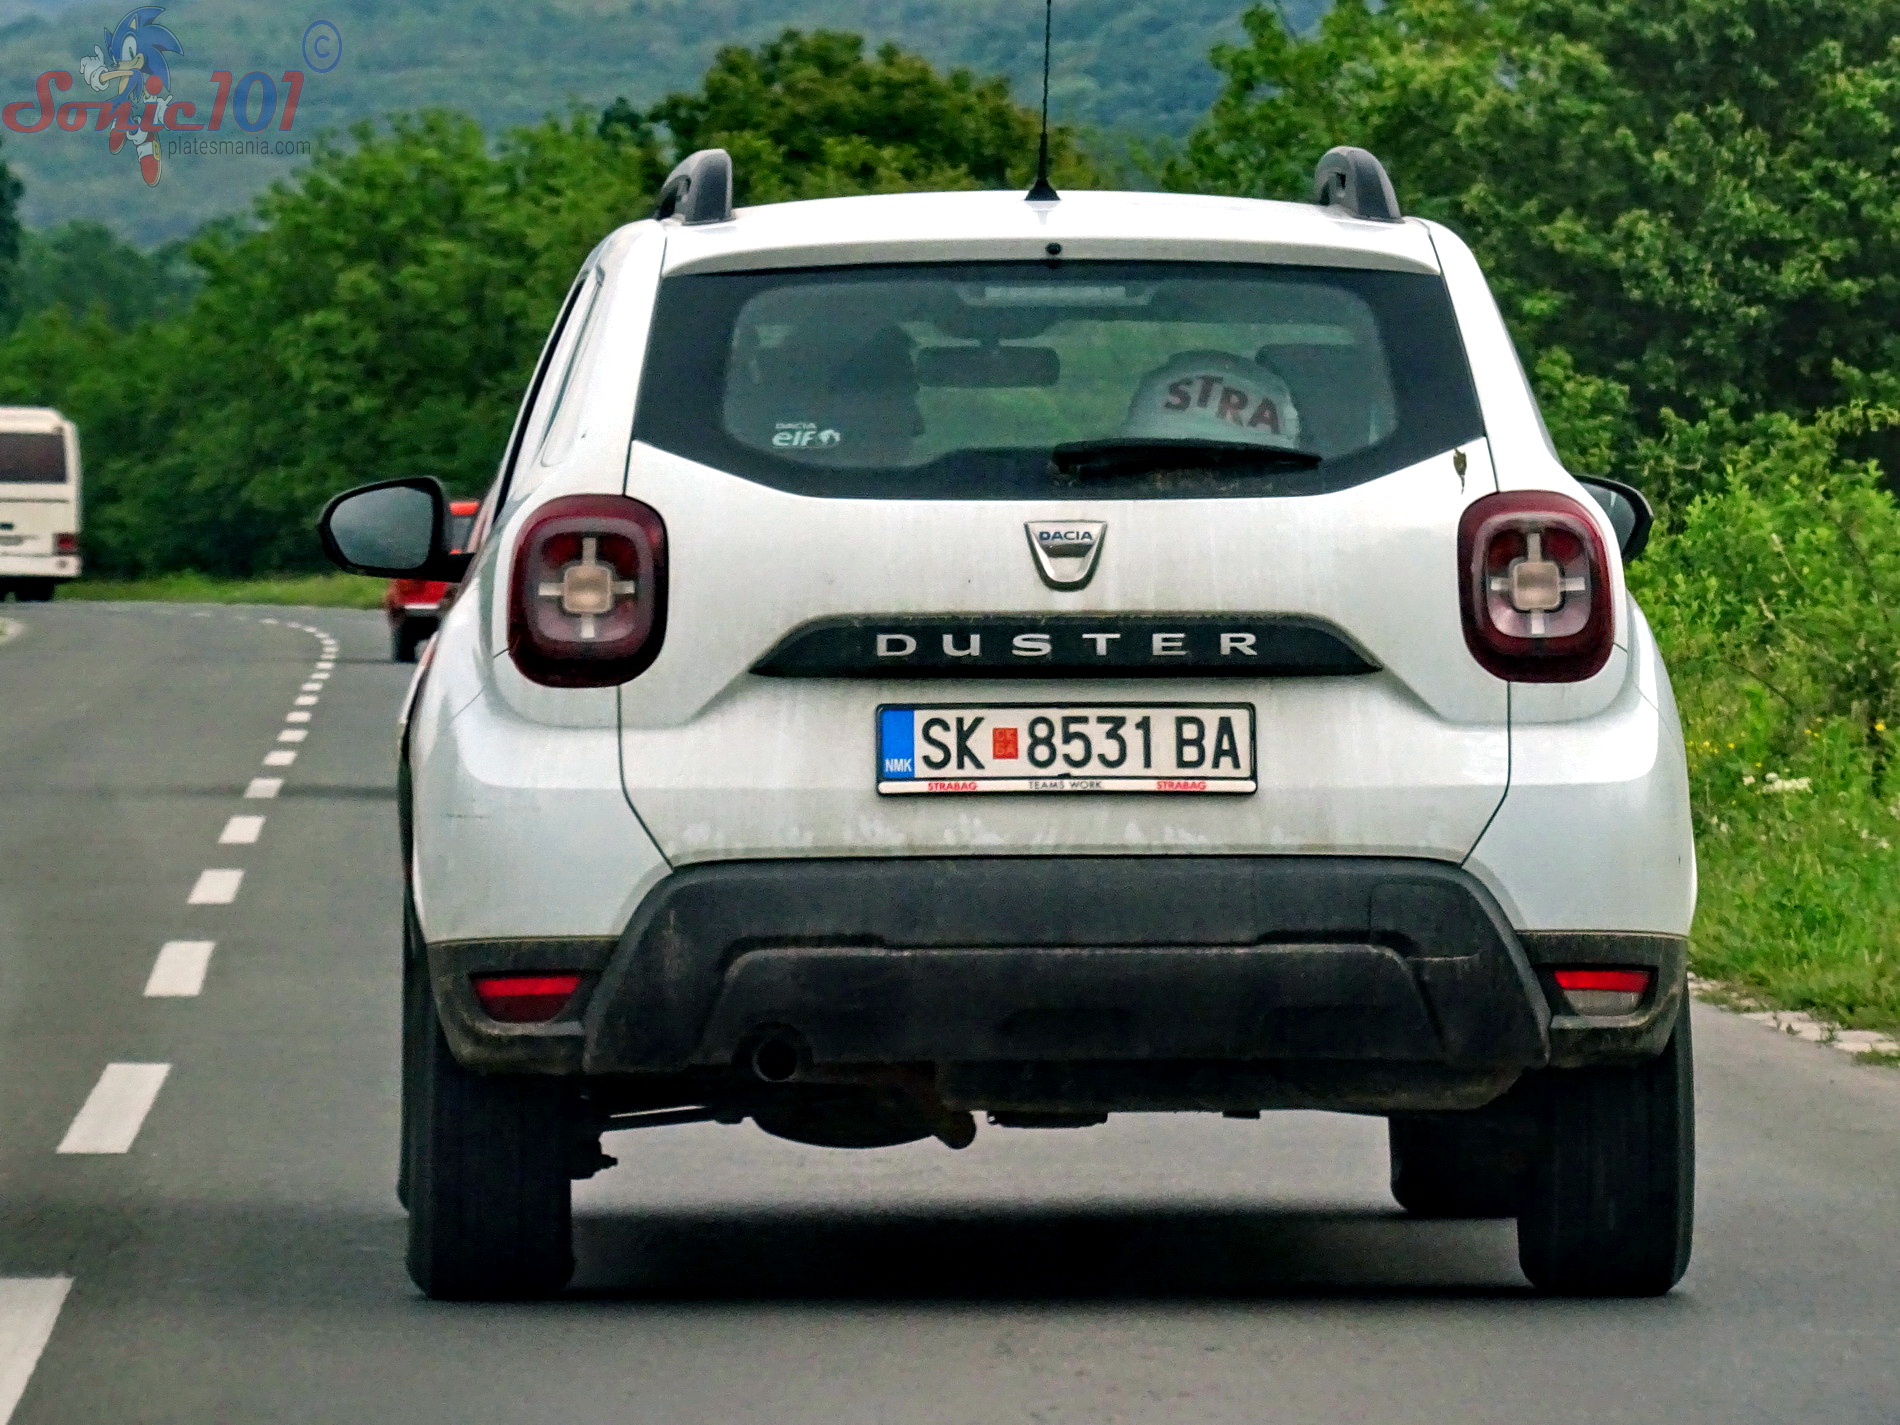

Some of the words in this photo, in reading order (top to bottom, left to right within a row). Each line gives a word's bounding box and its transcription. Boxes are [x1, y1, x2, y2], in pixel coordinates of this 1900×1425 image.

[1163, 374, 1281, 434] STRA
[1038, 530, 1093, 541] DACIA
[876, 633, 1258, 656] DUSTER
[921, 716, 985, 770] SK
[1027, 716, 1152, 769] 8531
[1175, 716, 1242, 769] BA
[885, 758, 912, 773] NMK
[927, 781, 978, 791] STRABAG
[1028, 780, 1065, 790] TEAMS
[1069, 780, 1102, 790] WORK
[1156, 781, 1207, 791] STRABAG
